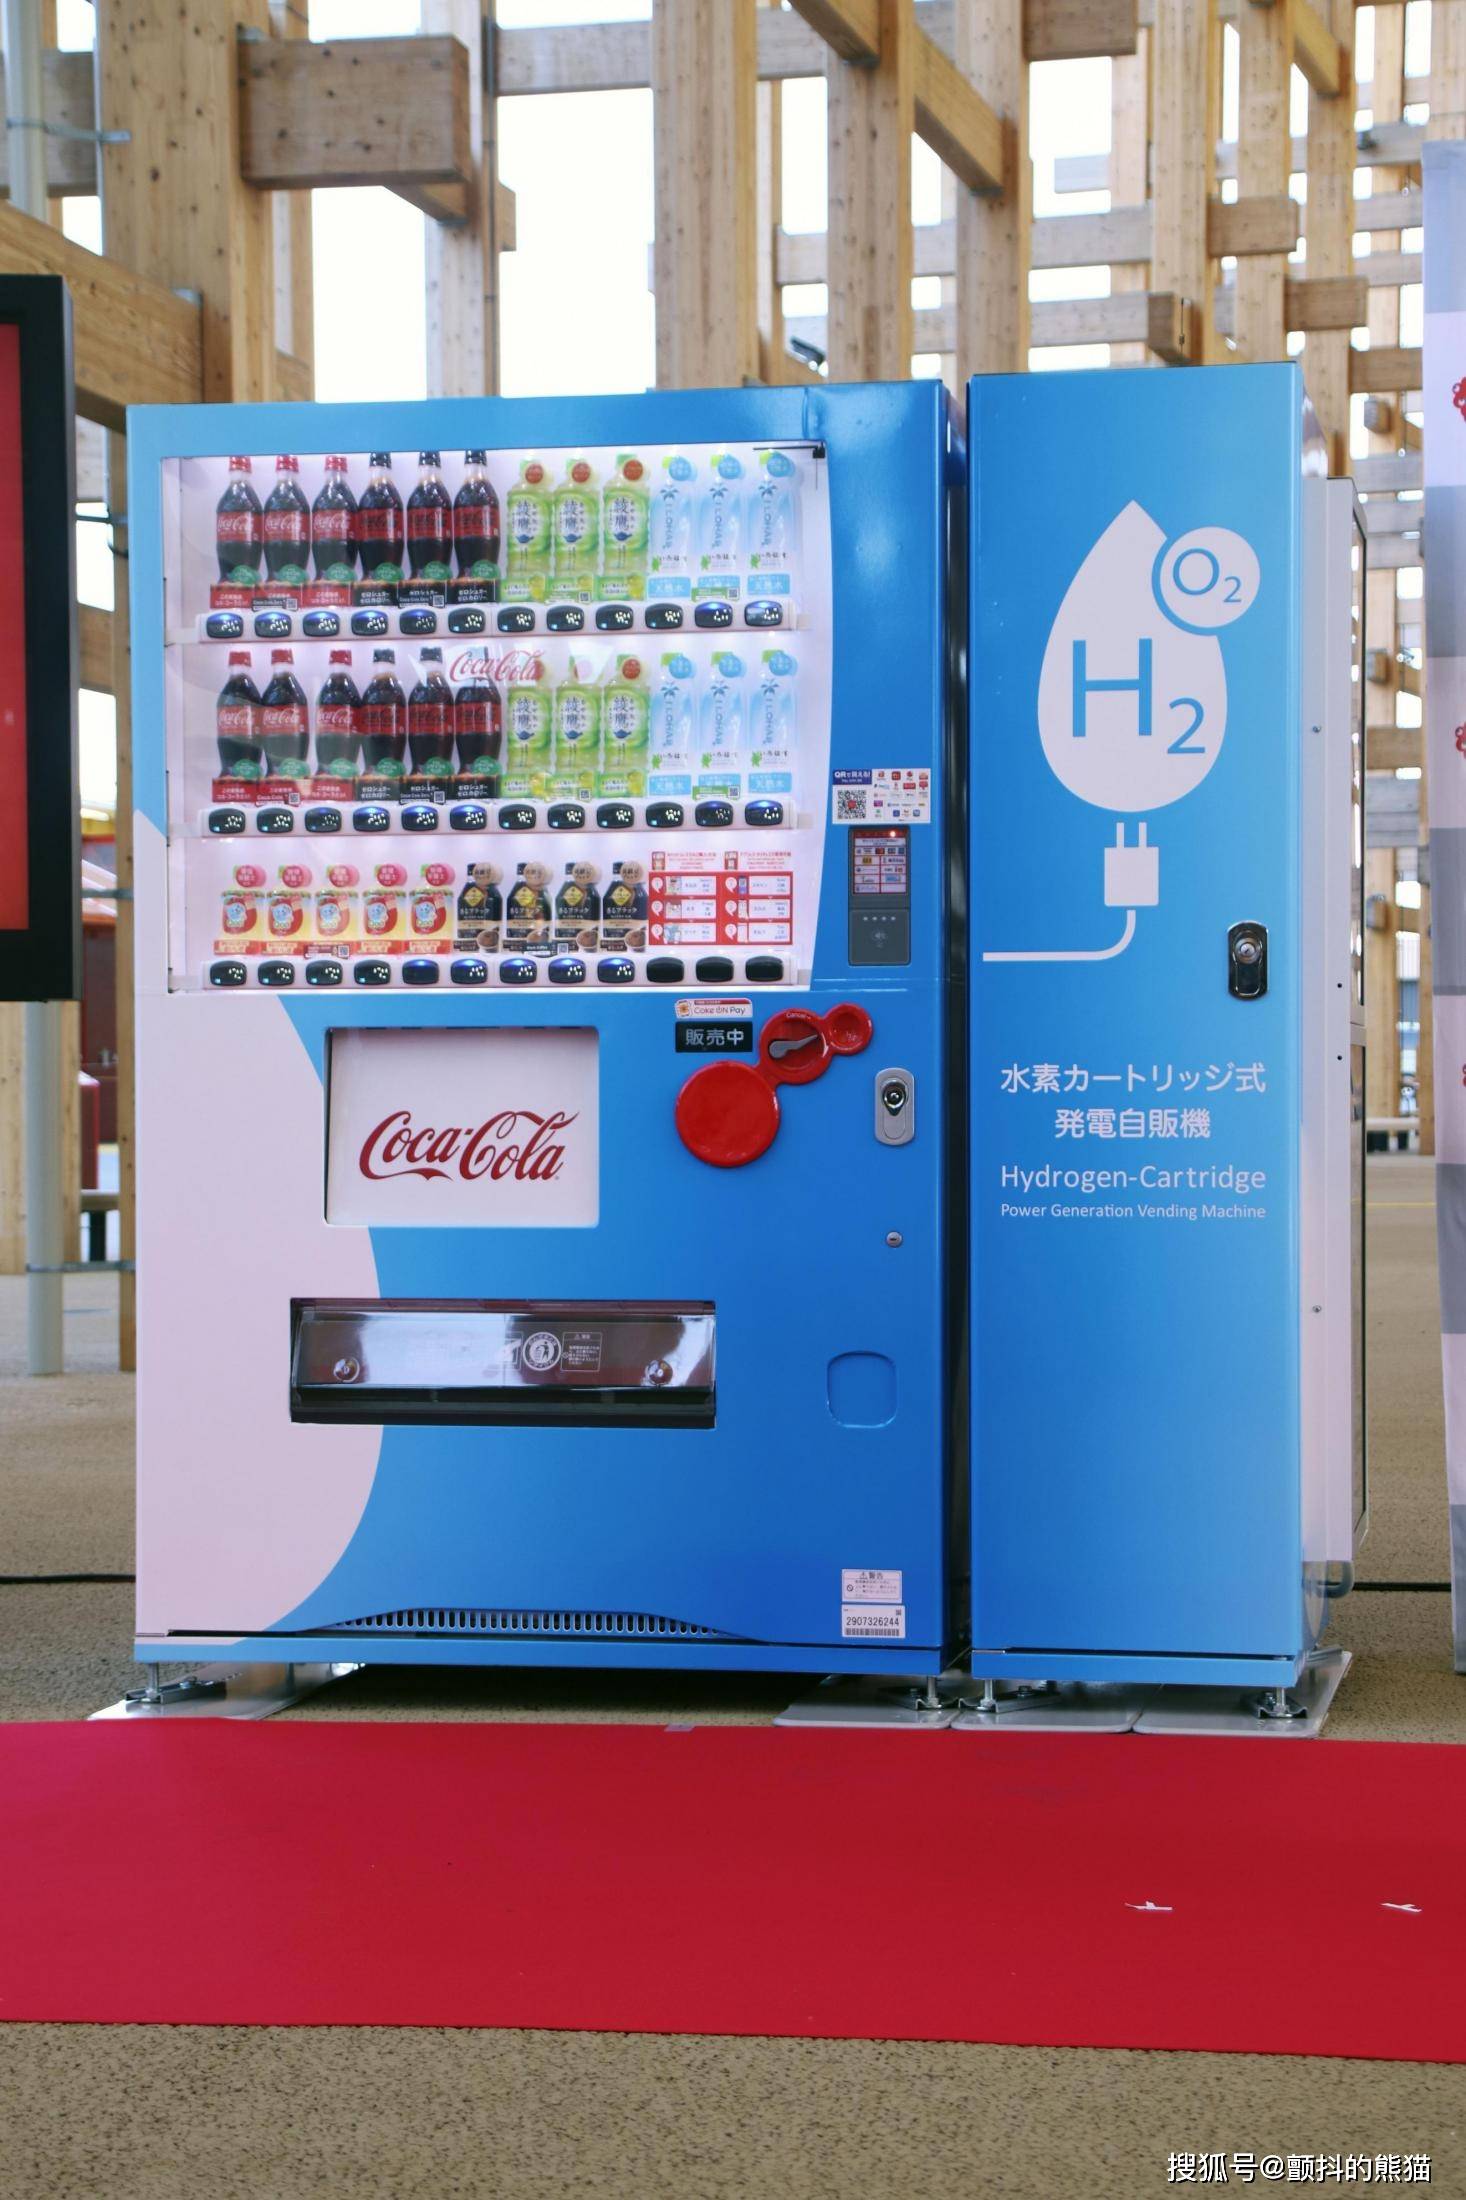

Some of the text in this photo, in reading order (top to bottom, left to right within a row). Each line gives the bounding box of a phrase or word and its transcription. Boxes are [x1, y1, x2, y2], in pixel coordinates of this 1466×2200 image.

[694, 1006, 715, 1015] Coke
[730, 1006, 746, 1016] Pay
[685, 1028, 745, 1047] 販売中
[1000, 1062, 1266, 1094] 水素カートリッジ式
[1055, 1107, 1211, 1139] 発電自販機
[359, 1110, 580, 1182] Coca-Cola
[1001, 1164, 1267, 1193] Hydrogen-Cartridge
[1001, 1203, 1266, 1221] Power Generation Vending Machine
[846, 1617, 900, 1626] 2907326244
